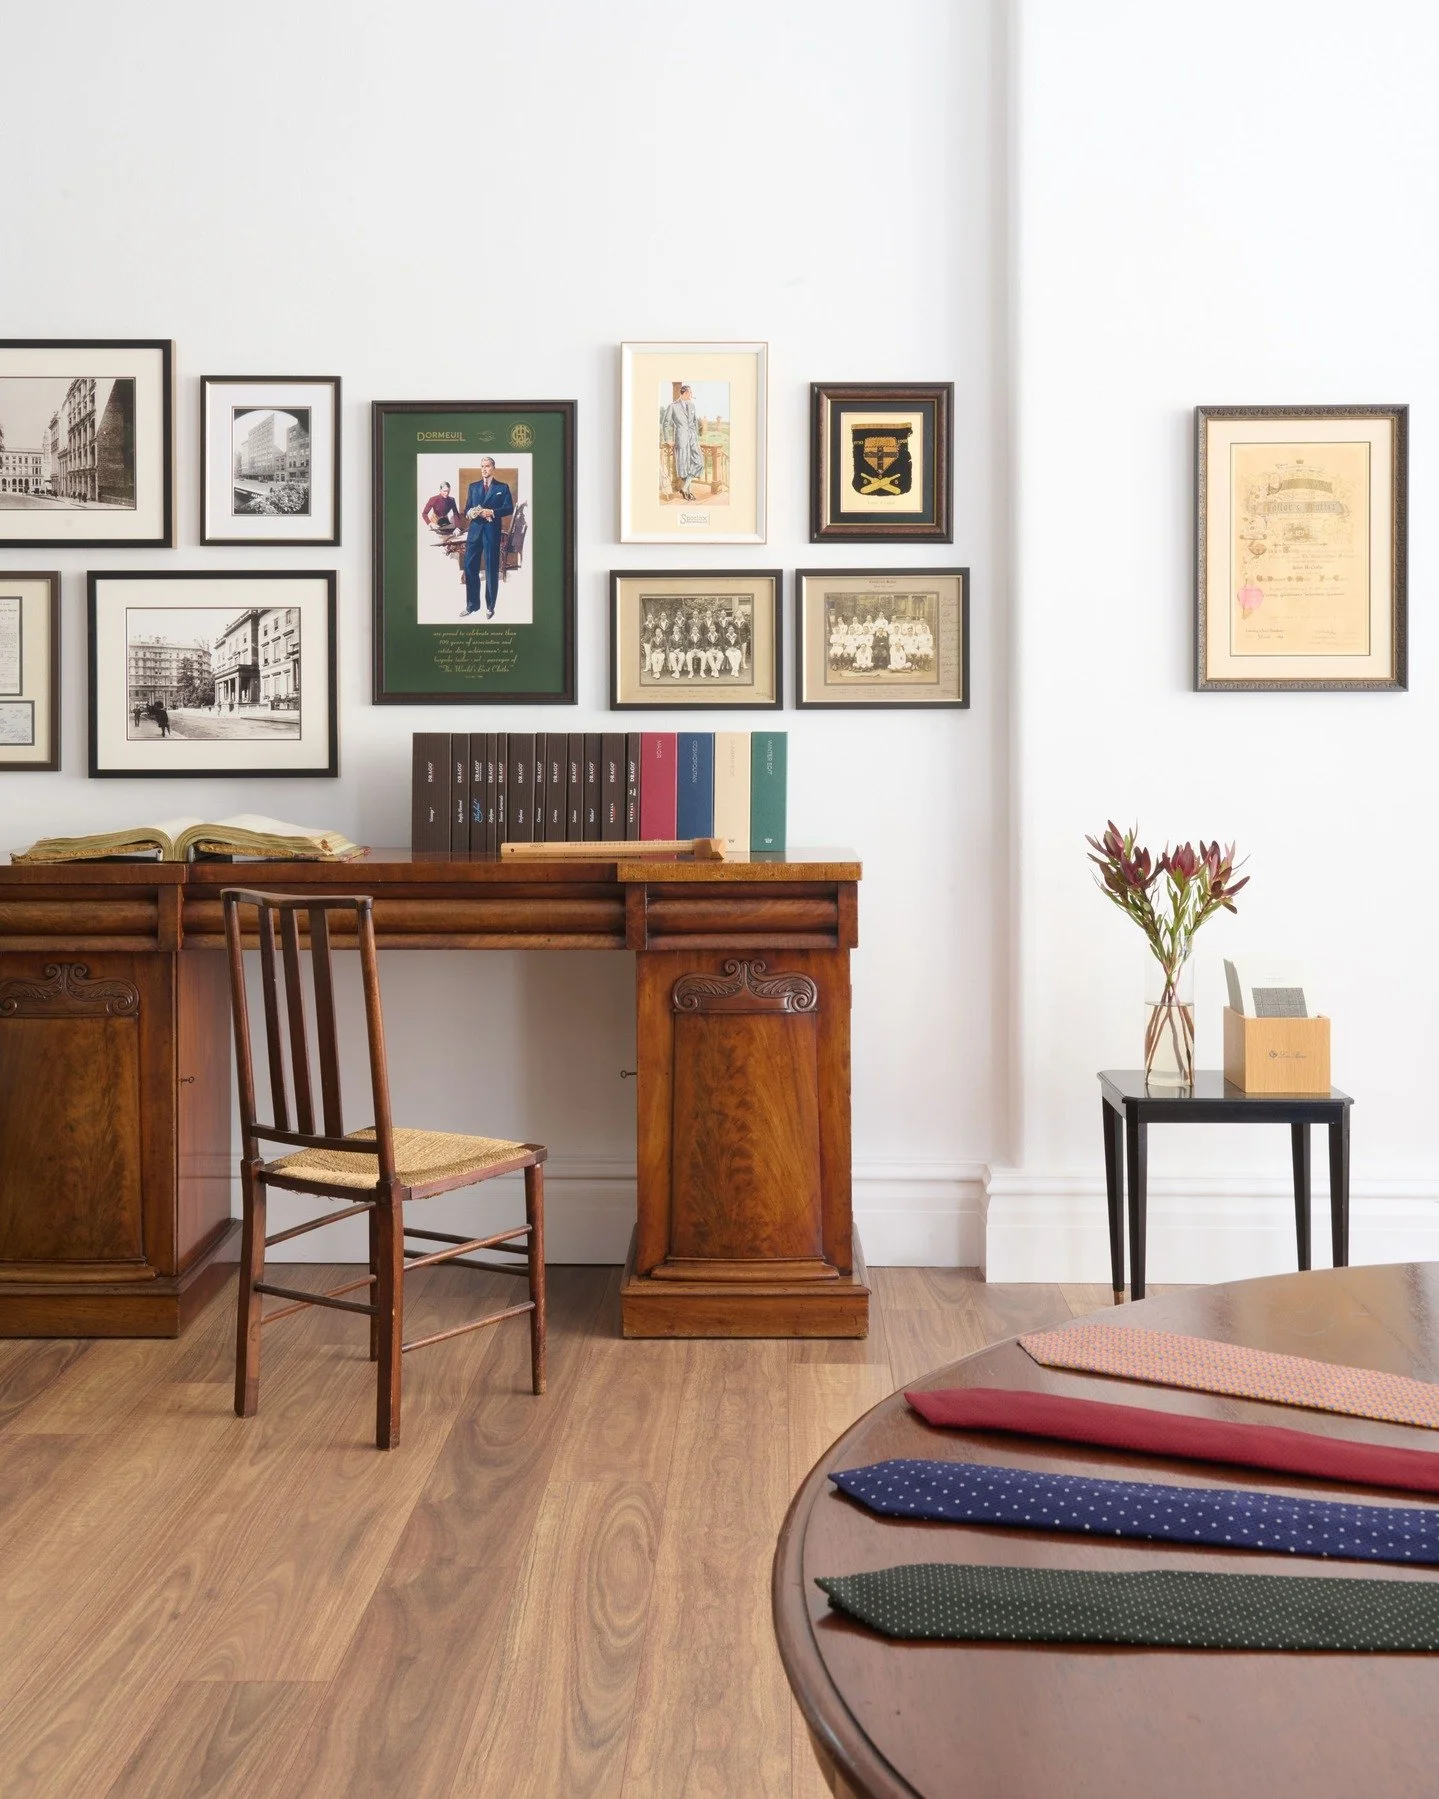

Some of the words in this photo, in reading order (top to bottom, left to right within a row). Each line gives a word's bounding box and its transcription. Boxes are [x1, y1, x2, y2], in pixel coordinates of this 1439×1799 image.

[417, 432, 466, 442] DORMEUIL
[441, 629, 459, 638] proud
[466, 628, 489, 636] celebrate
[504, 628, 517, 636] than
[465, 637, 472, 647] of
[501, 637, 513, 645] and
[510, 654, 518, 664] of
[477, 664, 491, 673] Best
